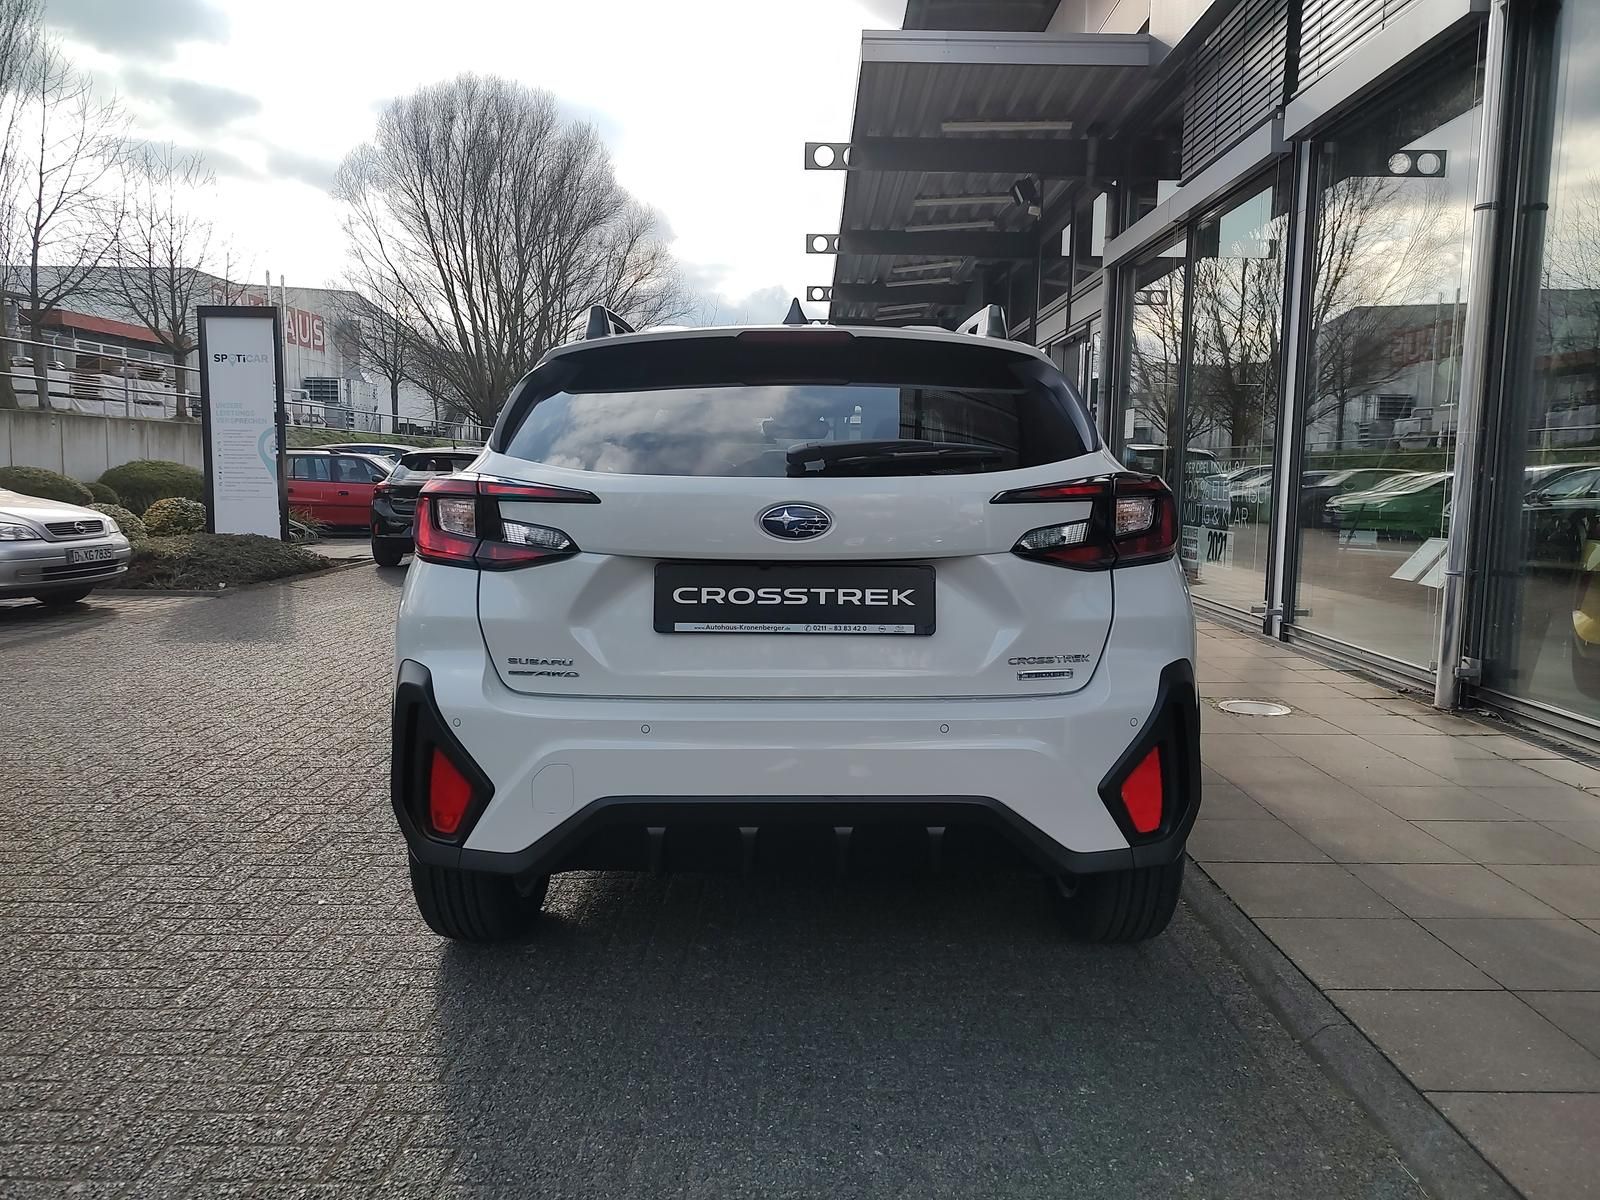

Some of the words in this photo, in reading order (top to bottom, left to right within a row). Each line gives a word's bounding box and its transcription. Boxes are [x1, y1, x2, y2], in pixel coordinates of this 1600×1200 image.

[1183, 502, 1210, 525] MUTIG
[1212, 505, 1219, 525] &
[1207, 530, 1228, 564] 2021
[672, 587, 916, 606] CROSSTREK
[507, 657, 574, 666] SUBARU
[1007, 654, 1090, 665] CROSSTREK
